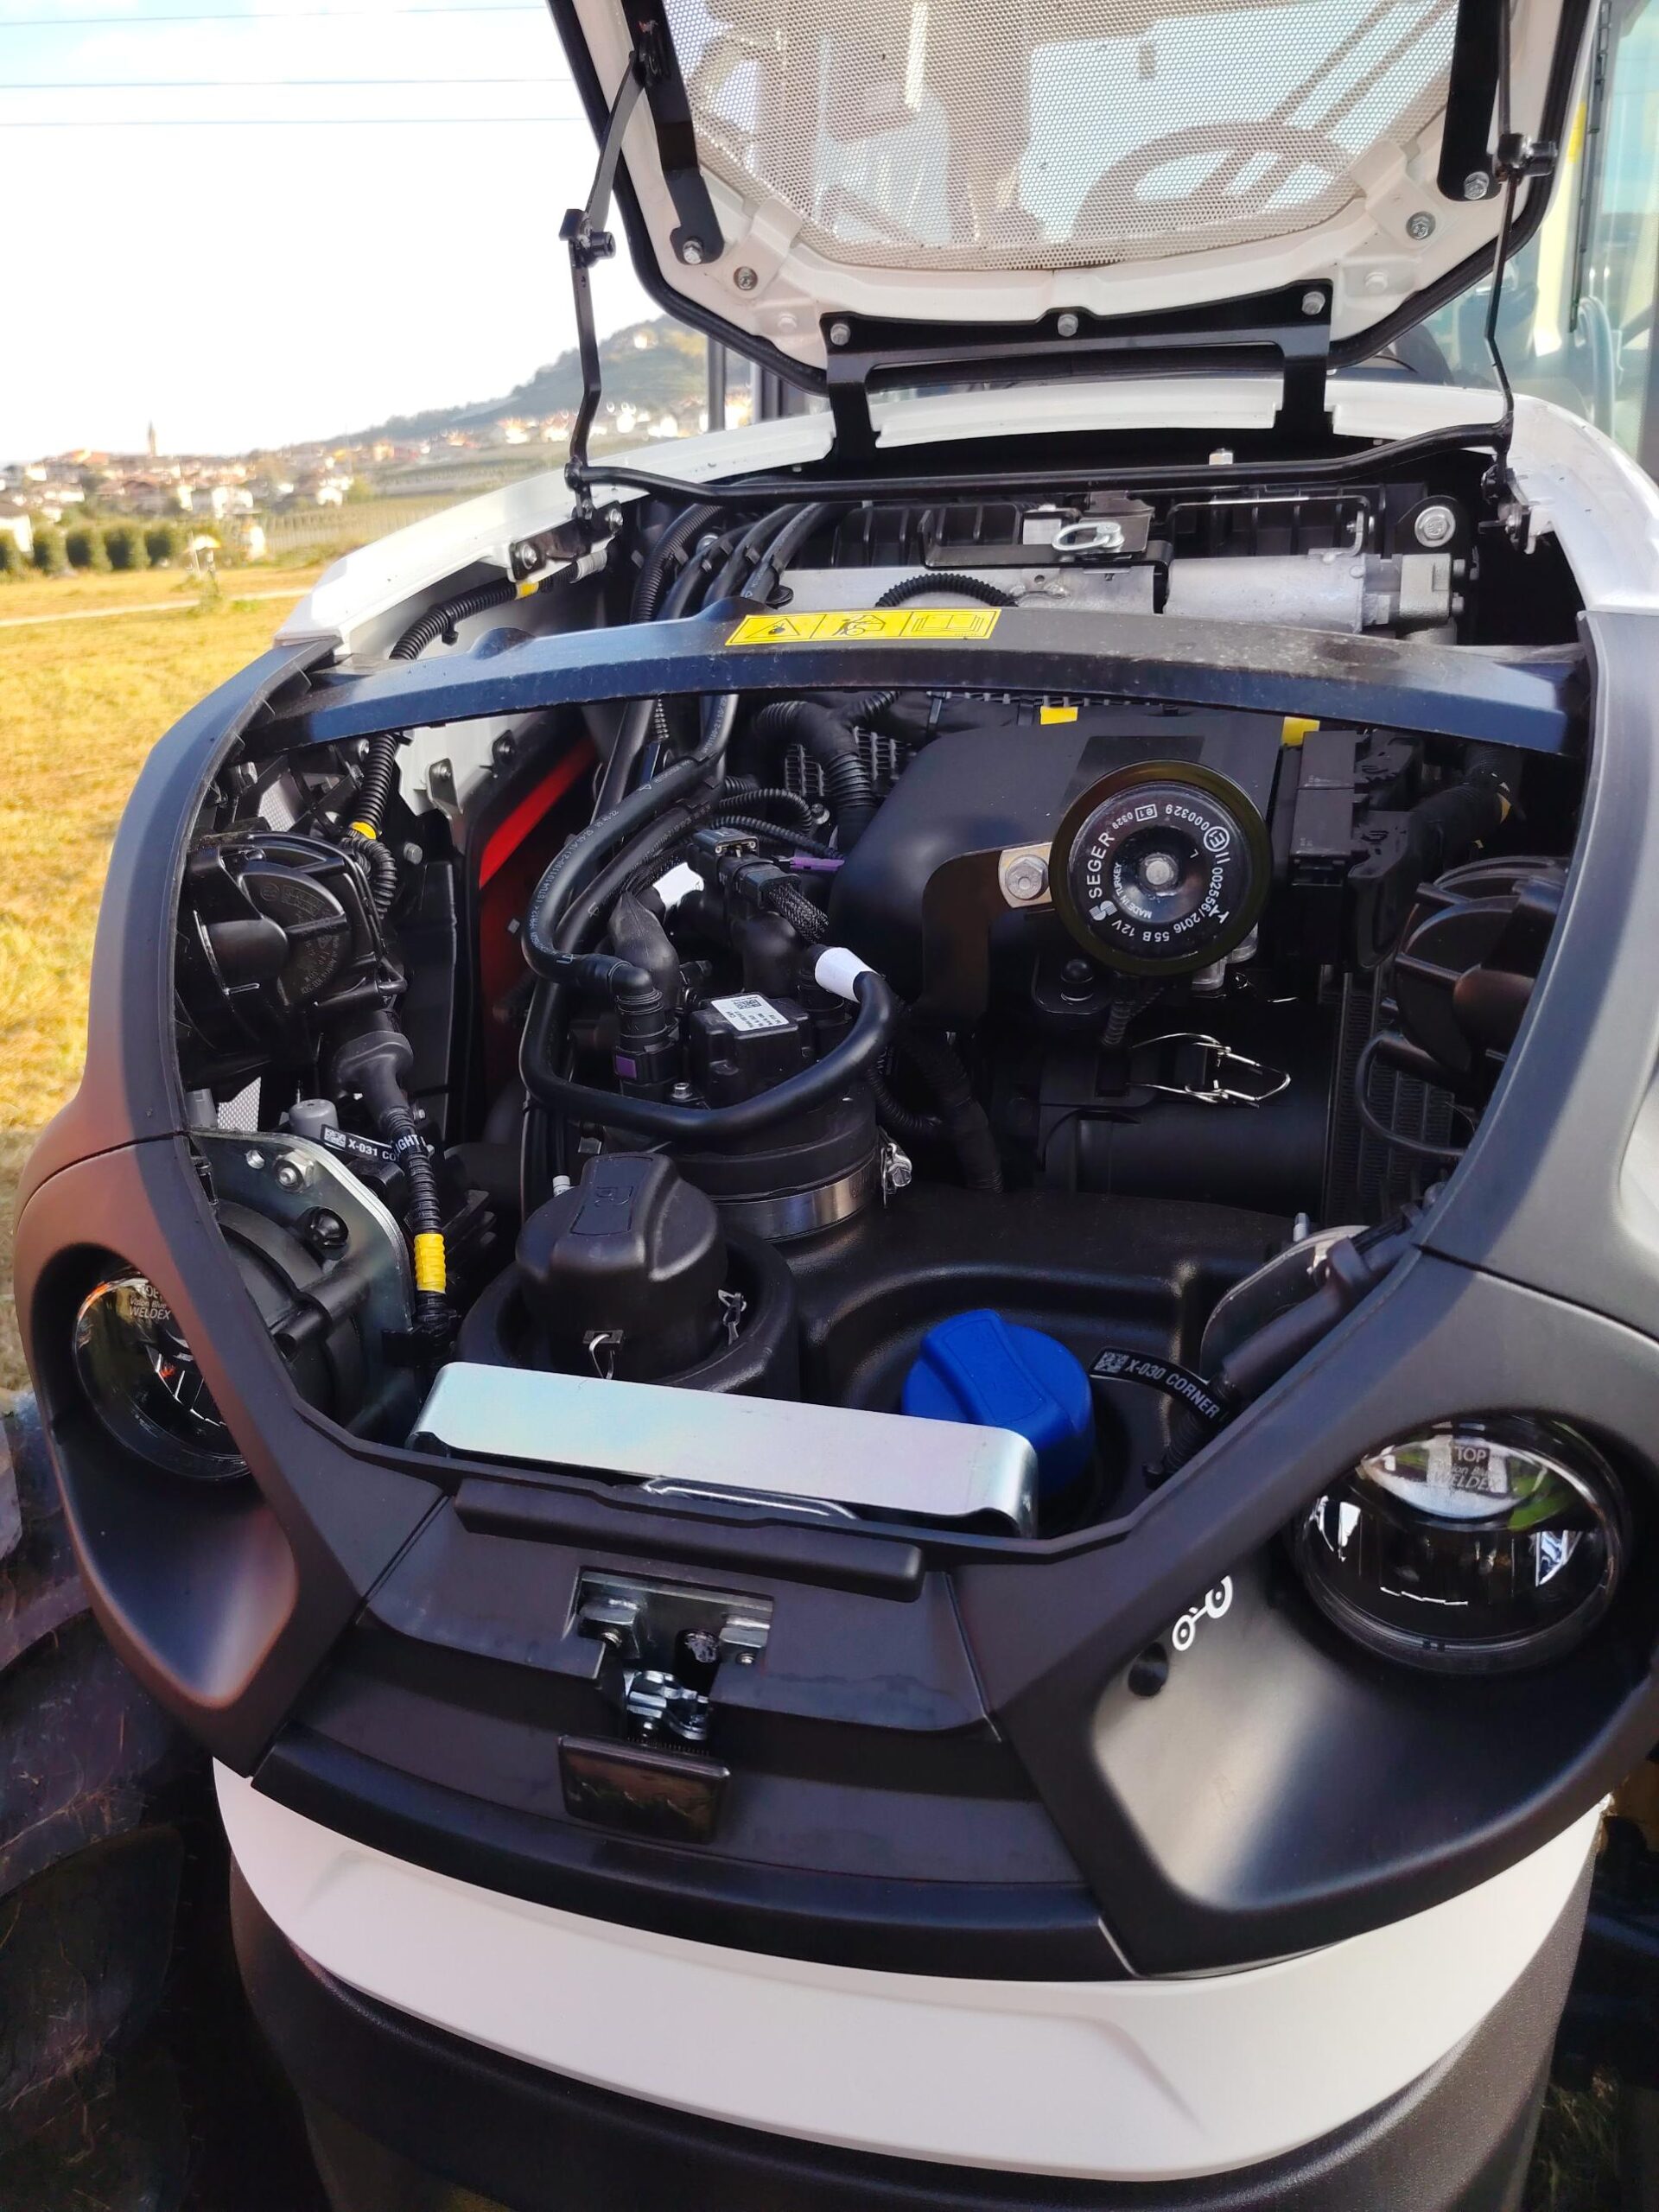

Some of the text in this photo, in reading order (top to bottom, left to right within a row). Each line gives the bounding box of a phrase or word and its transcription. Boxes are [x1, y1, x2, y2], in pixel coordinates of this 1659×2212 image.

[1112, 811, 1134, 830] 0329
[1165, 804, 1210, 831] 000329
[1087, 832, 1116, 899] SEGER
[1113, 862, 1153, 918] MADE IN TURKEY
[1111, 919, 1135, 937] 12V
[347, 1138, 378, 1157] X-031
[394, 1135, 420, 1154] IGHT
[130, 1305, 171, 1320] WELDEX
[1125, 1359, 1220, 1419] X-030 CORNER
[1454, 1446, 1487, 1463] TOP
